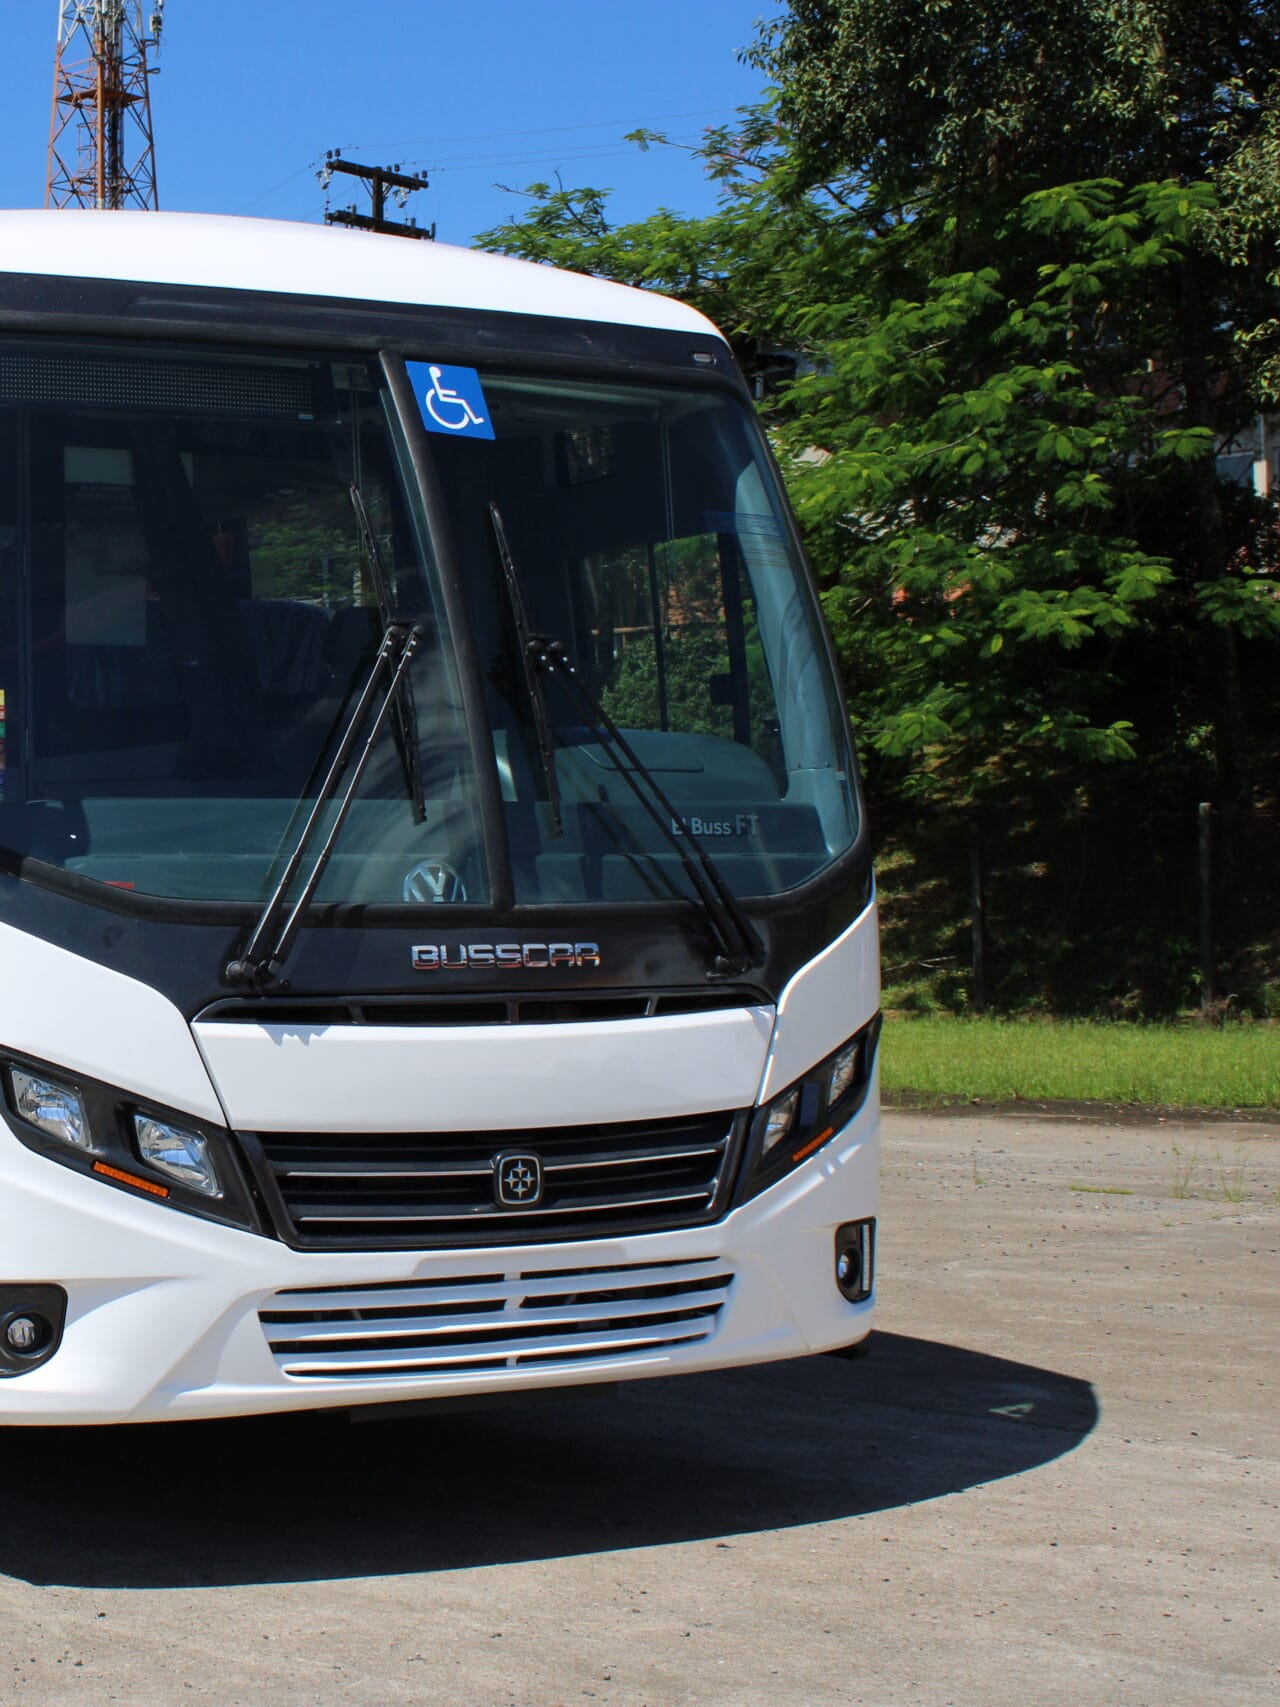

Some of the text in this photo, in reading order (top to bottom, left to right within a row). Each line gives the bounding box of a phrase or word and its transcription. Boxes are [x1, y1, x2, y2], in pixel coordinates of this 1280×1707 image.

[691, 818, 732, 835] Buss
[735, 814, 759, 835] FT
[411, 942, 601, 970] BUSSCAR
